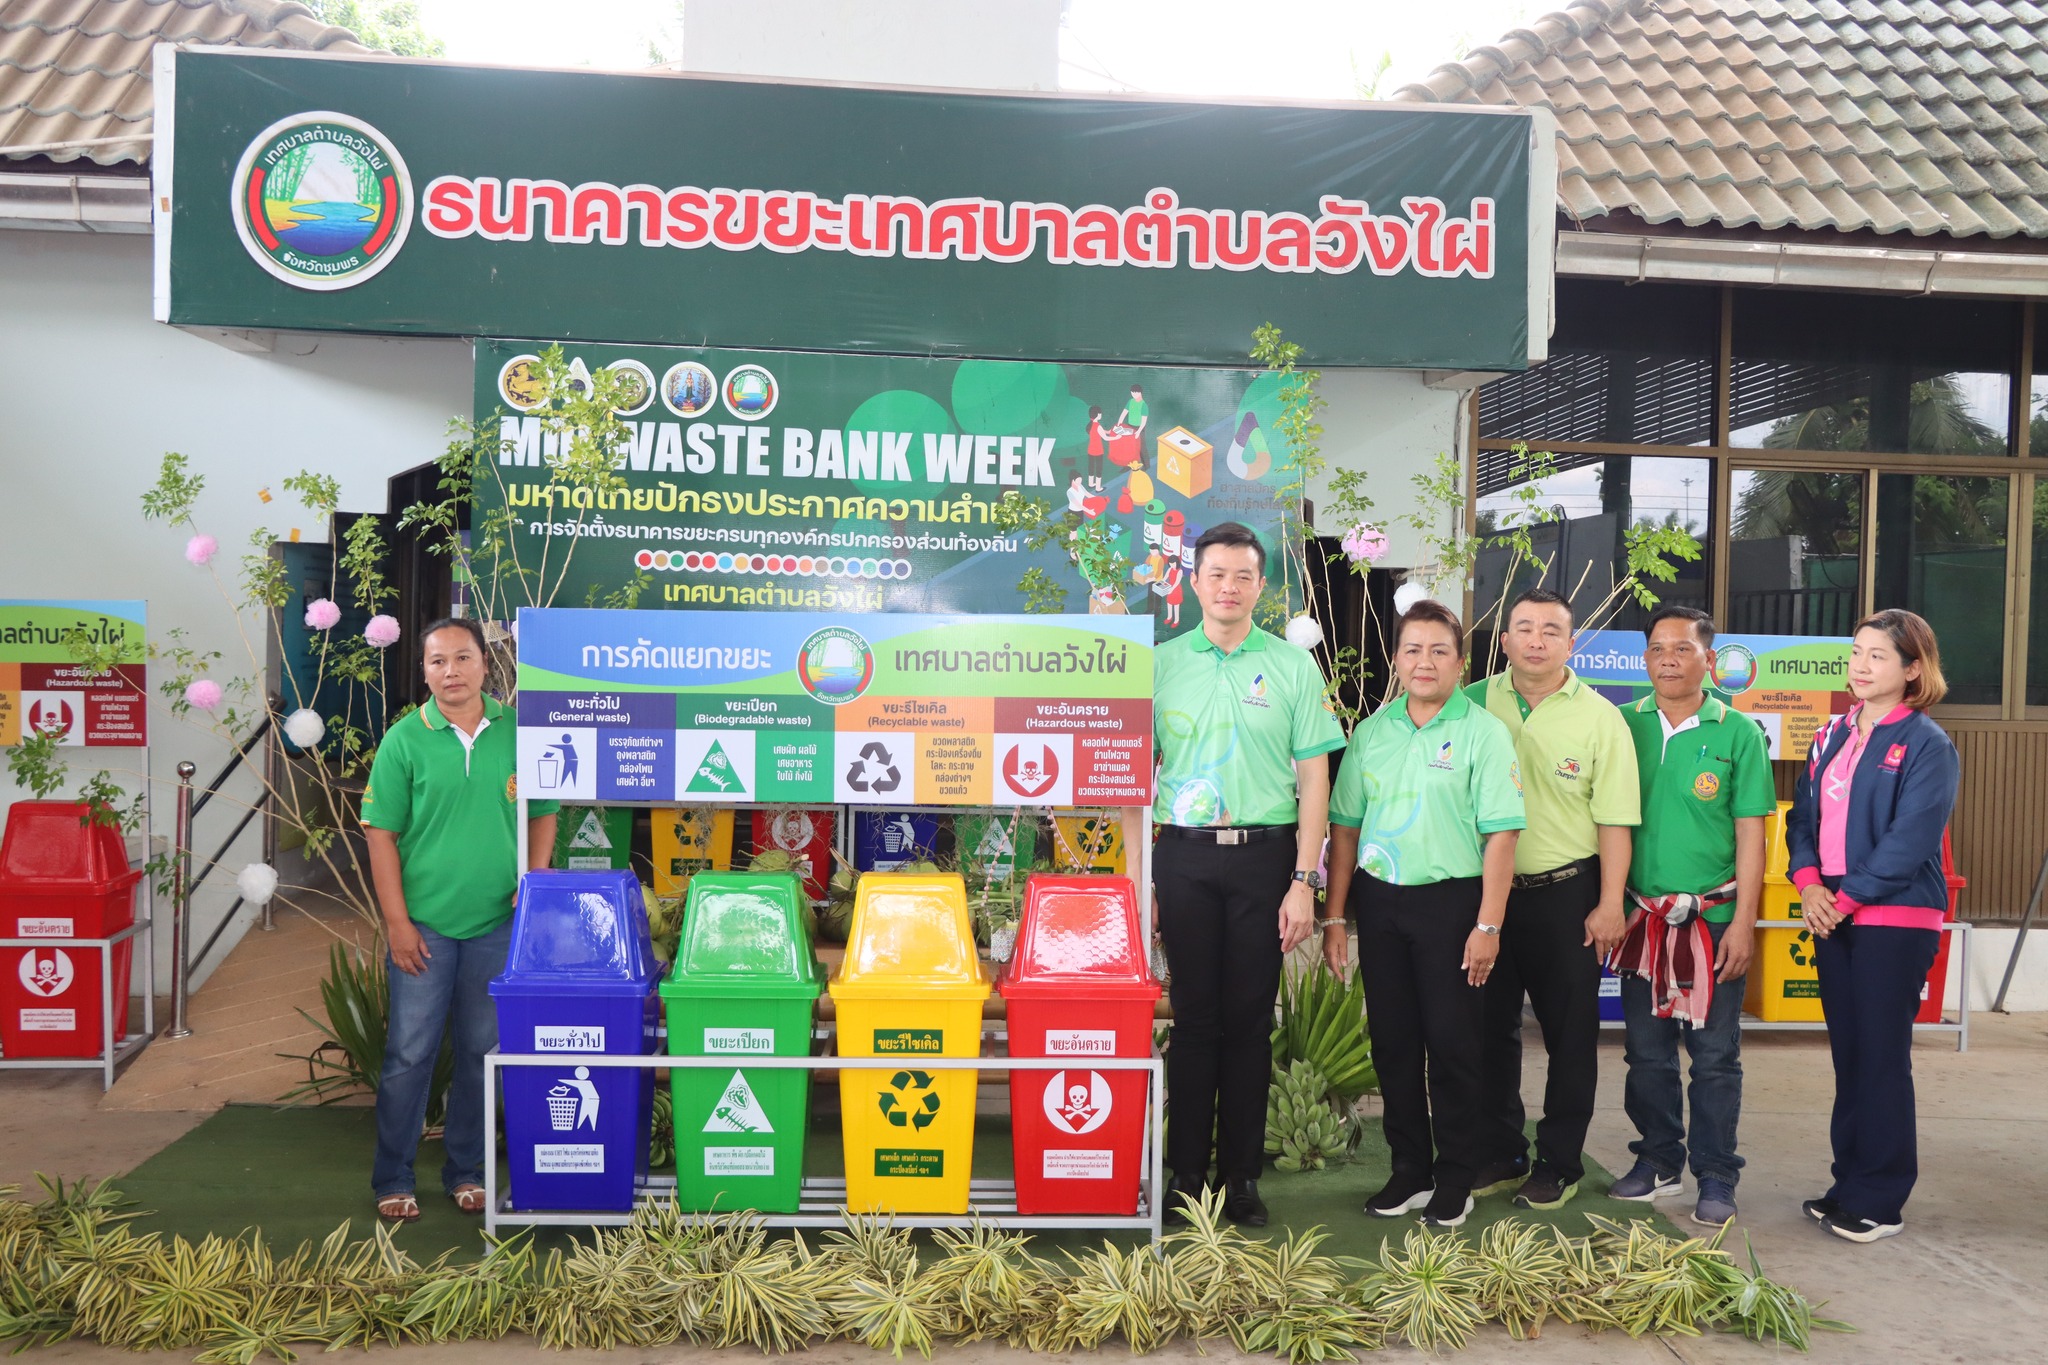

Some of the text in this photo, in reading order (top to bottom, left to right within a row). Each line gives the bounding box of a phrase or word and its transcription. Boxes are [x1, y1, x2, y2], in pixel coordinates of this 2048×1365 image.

[264, 126, 388, 171] เทศบาลตำบลวังไผ่
[422, 176, 1496, 279] ธนาคารขยะเทศบาลตำบลวังไผ่
[606, 420, 770, 477] WASTE
[782, 427, 914, 483] BANK
[922, 433, 1057, 487] WEEK
[531, 514, 1018, 553] การจัดตั้งธนาคารขยะครบทุกองค์กรปกครองส่วนท้องถิ่น
[664, 579, 884, 610] เทศบาลตำบลวังไผ่
[582, 638, 772, 670] การคัดแยกขยะ
[895, 639, 1127, 674] เทศบาลตำบลวังไผ่
[96, 679, 123, 688] waste)
[568, 692, 621, 710] ขยะทั่วไป
[725, 697, 777, 712] ขยะเปียก
[883, 701, 947, 714] ขยะรีไซเคิล
[1752, 702, 1790, 711] (Recyclable
[1036, 702, 1109, 716] ขยะอันตราย
[549, 711, 631, 724] (General waste)
[694, 714, 811, 727] (Biodegradable waste)
[867, 716, 965, 728] (Recyclable waste)
[1026, 717, 1123, 730] (Hazardous waste)
[932, 737, 976, 746] ขวดพลาสติก
[1082, 737, 1110, 748] หลอดไฟ
[616, 750, 656, 761] ถุงพลาสติก
[773, 744, 817, 755] เศษผัก ผลไม้
[777, 759, 813, 768] เศษอาหาร
[930, 760, 974, 770] โลหะ กระดาษ
[22, 920, 71, 934] ขยะอันตราย
[539, 1030, 602, 1049] ขยะทั่วไป
[708, 1032, 770, 1050] ขยะเปียก
[877, 1032, 940, 1051] ขยะรีไซเคิล
[1050, 1033, 1112, 1052] ขยะอันตราย
